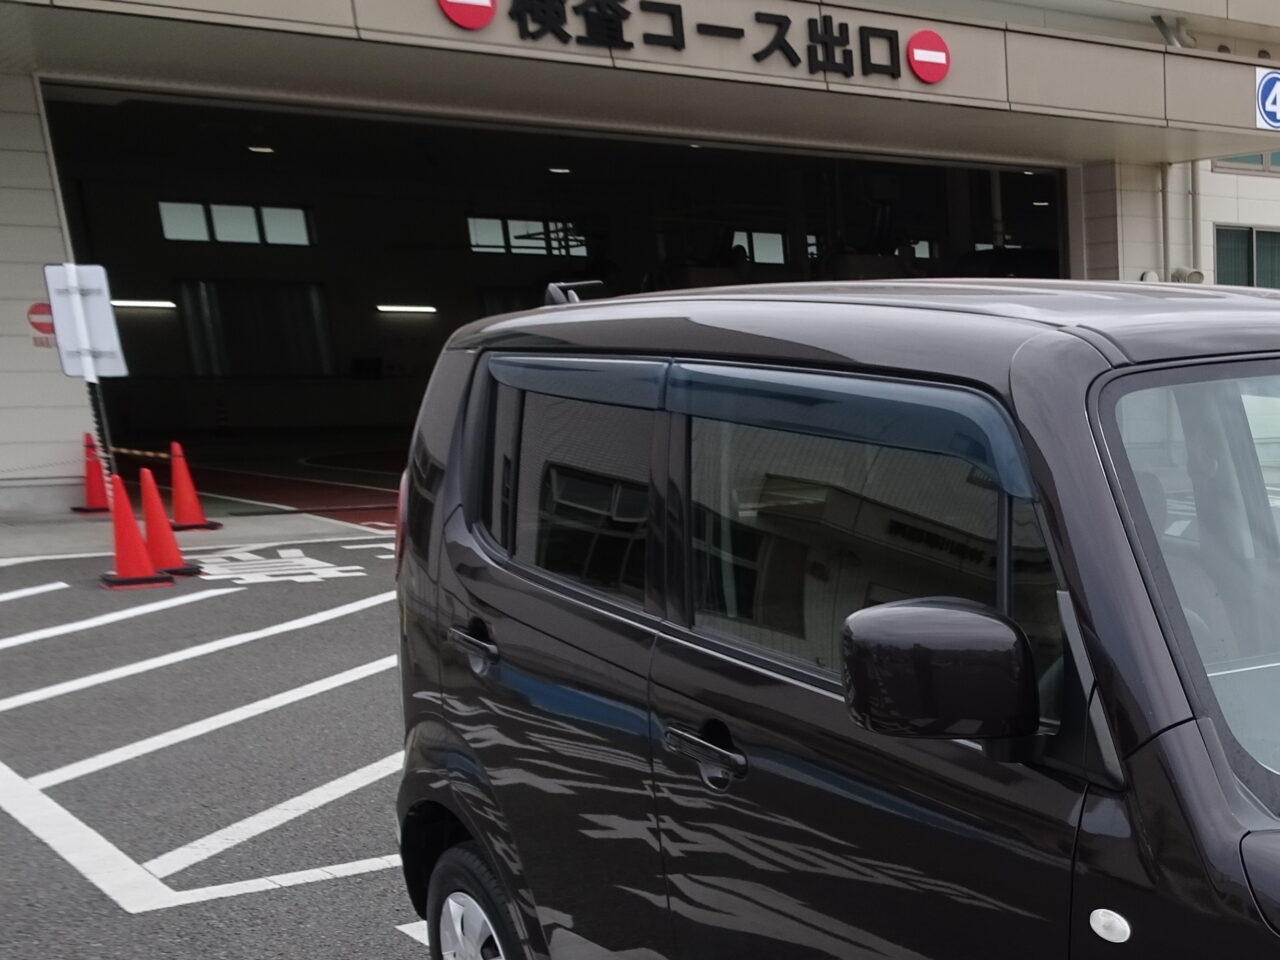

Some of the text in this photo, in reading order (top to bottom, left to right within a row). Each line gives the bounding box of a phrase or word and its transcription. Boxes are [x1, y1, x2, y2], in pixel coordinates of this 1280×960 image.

[509, 0, 901, 78] 検査コース出口
